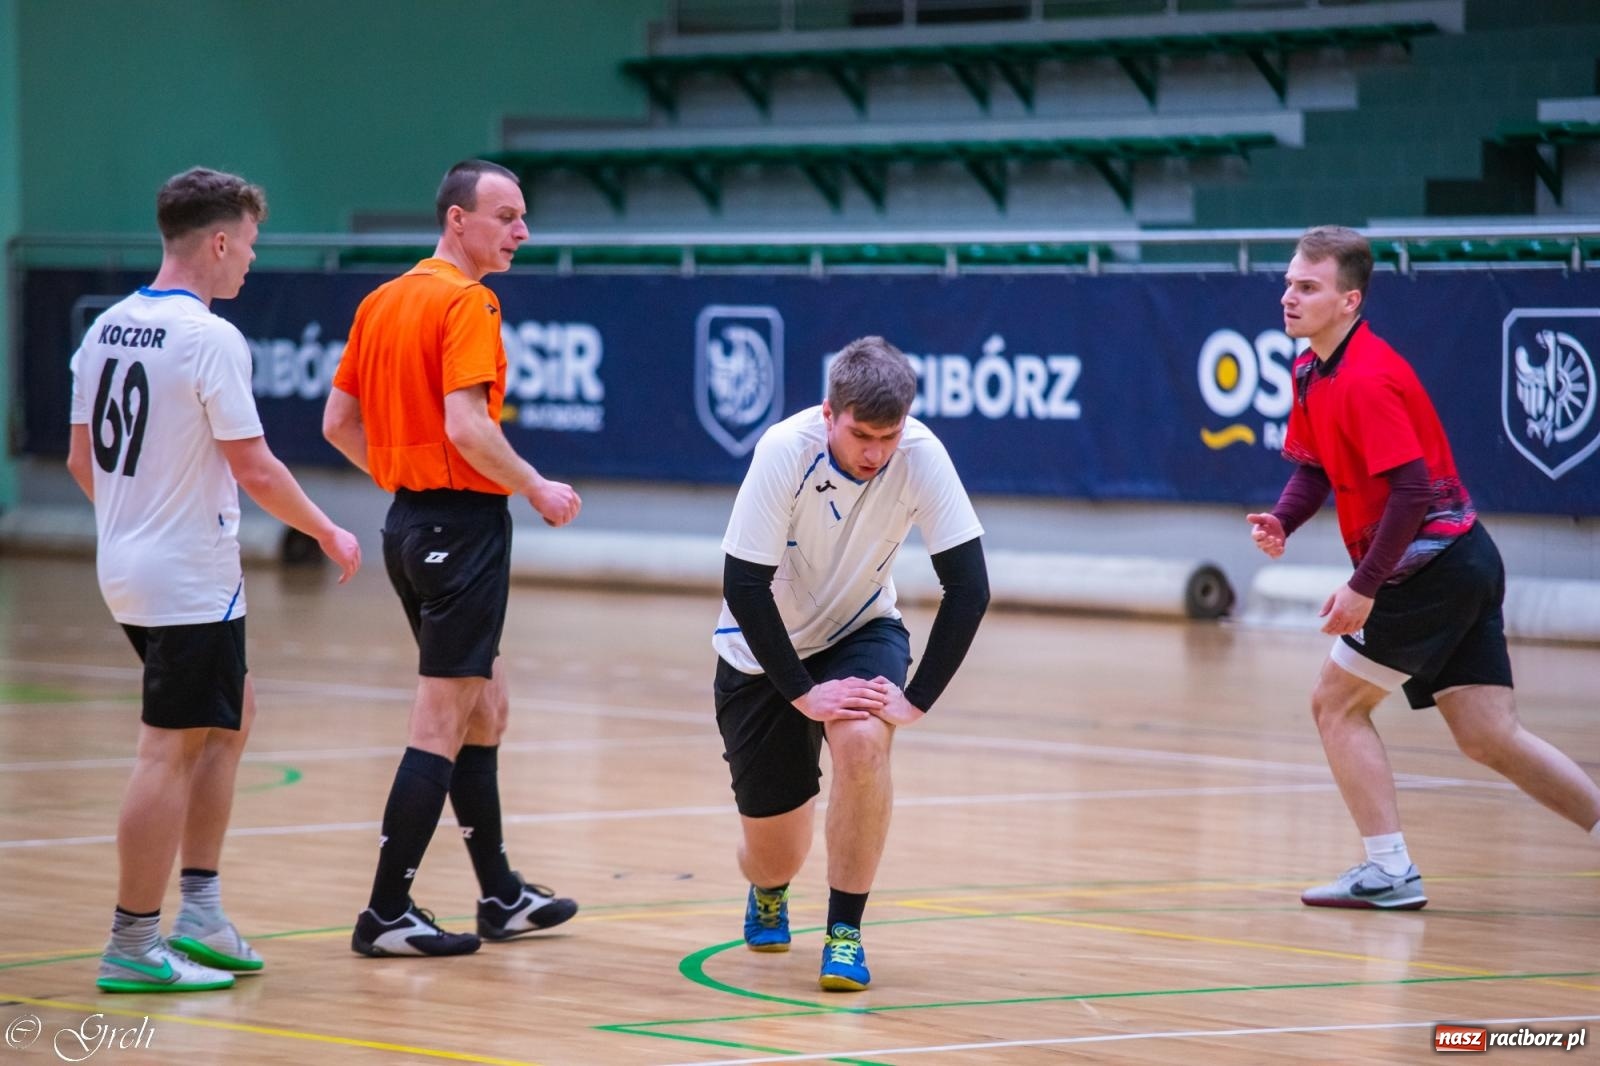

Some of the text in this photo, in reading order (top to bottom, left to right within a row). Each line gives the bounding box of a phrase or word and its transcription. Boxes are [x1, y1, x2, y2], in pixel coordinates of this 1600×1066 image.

[98, 324, 166, 348] KOCZOR
[501, 321, 604, 401] SiR
[92, 358, 149, 477] 69
